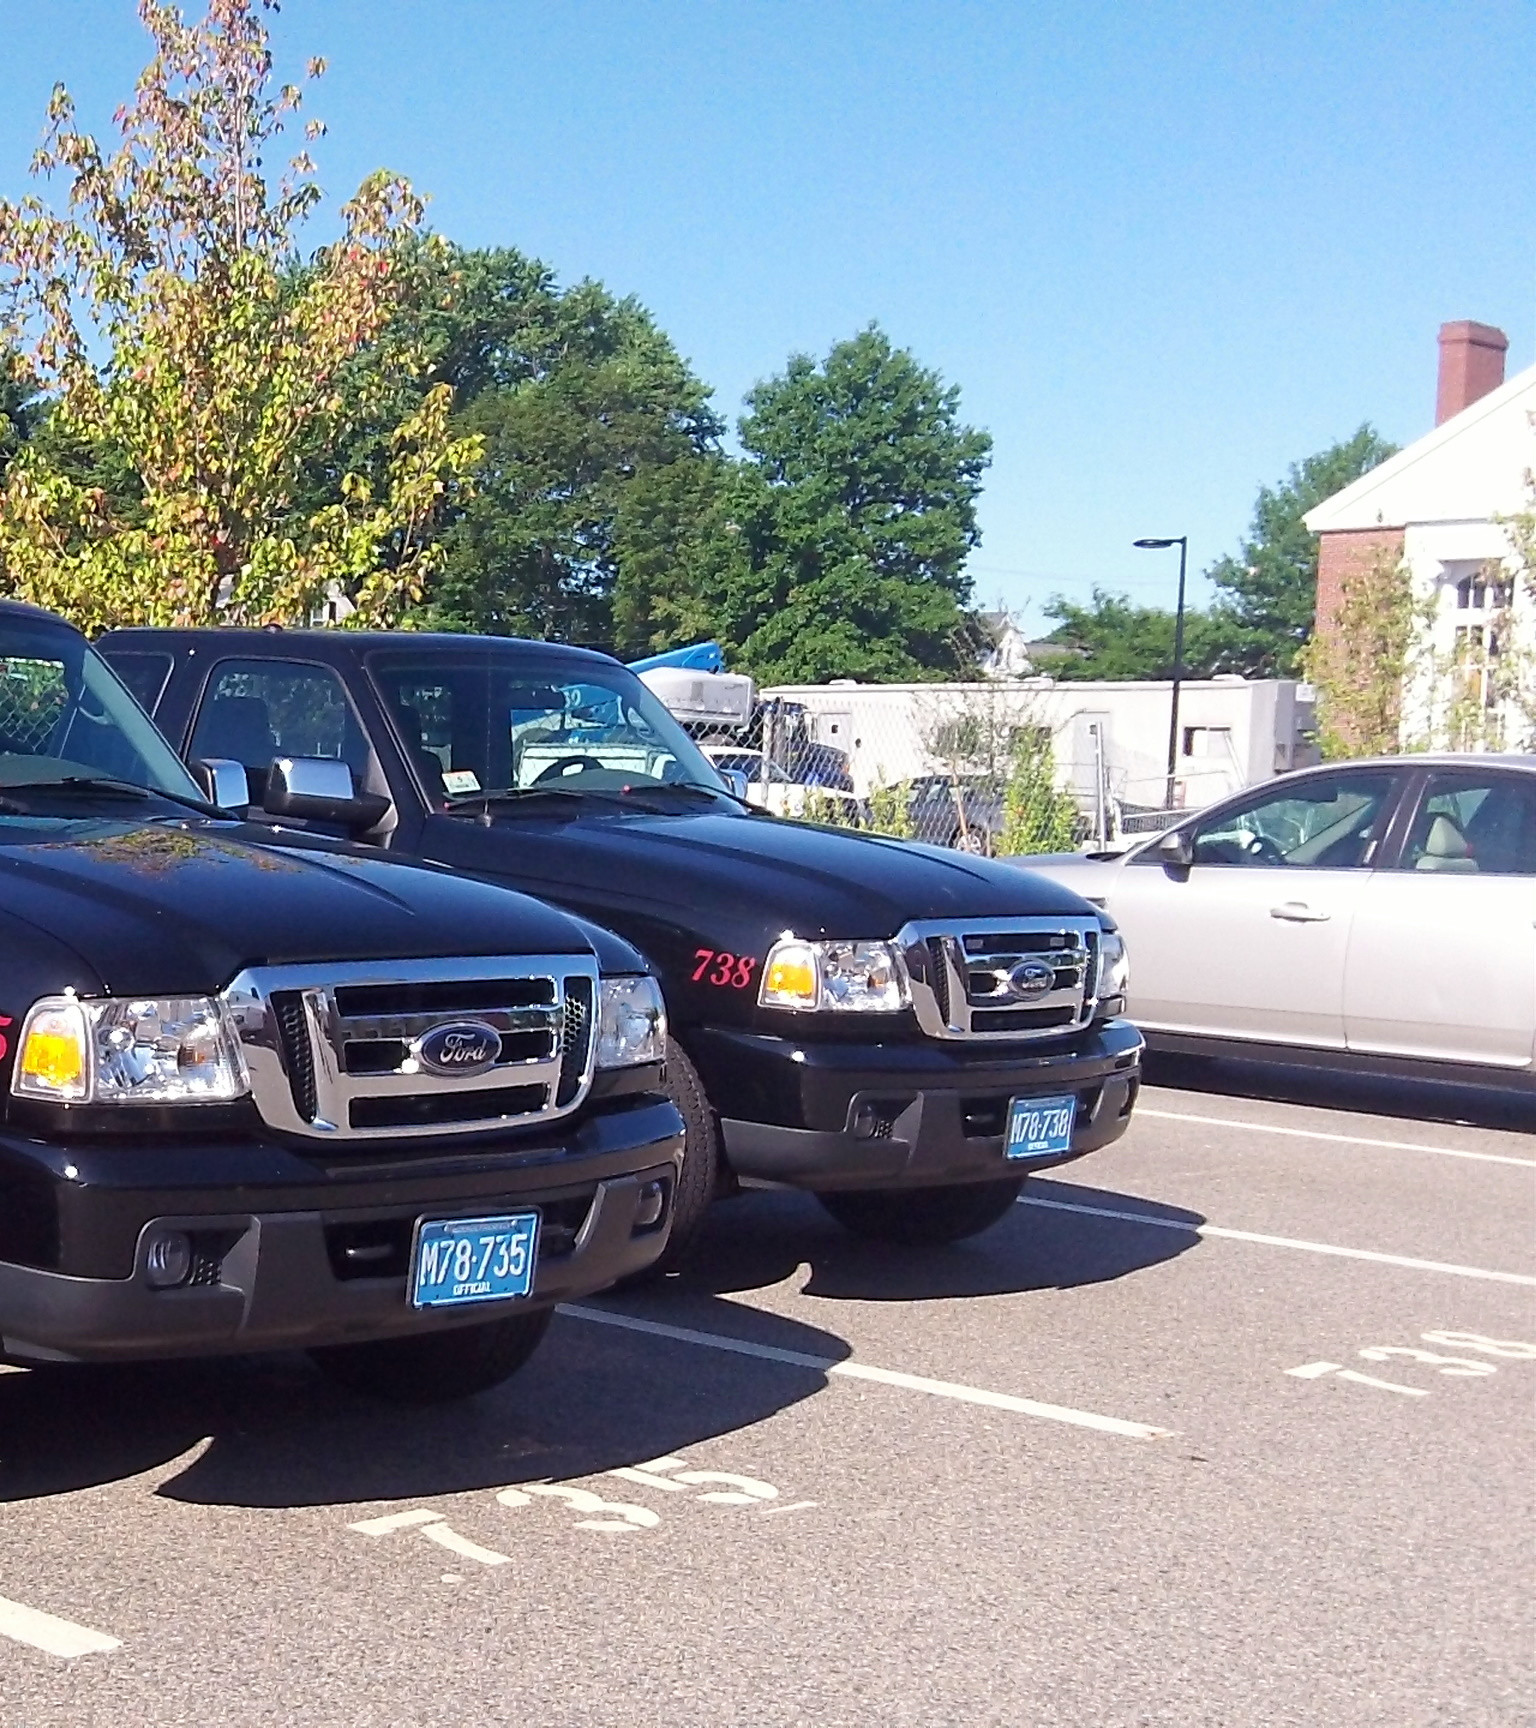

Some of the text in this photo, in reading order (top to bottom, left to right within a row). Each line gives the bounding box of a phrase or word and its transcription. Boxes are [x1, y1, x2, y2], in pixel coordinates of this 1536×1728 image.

[691, 949, 757, 988] 738
[439, 1032, 488, 1064] Ford
[1282, 1329, 1536, 1396] 738
[346, 1456, 780, 1565] 735
